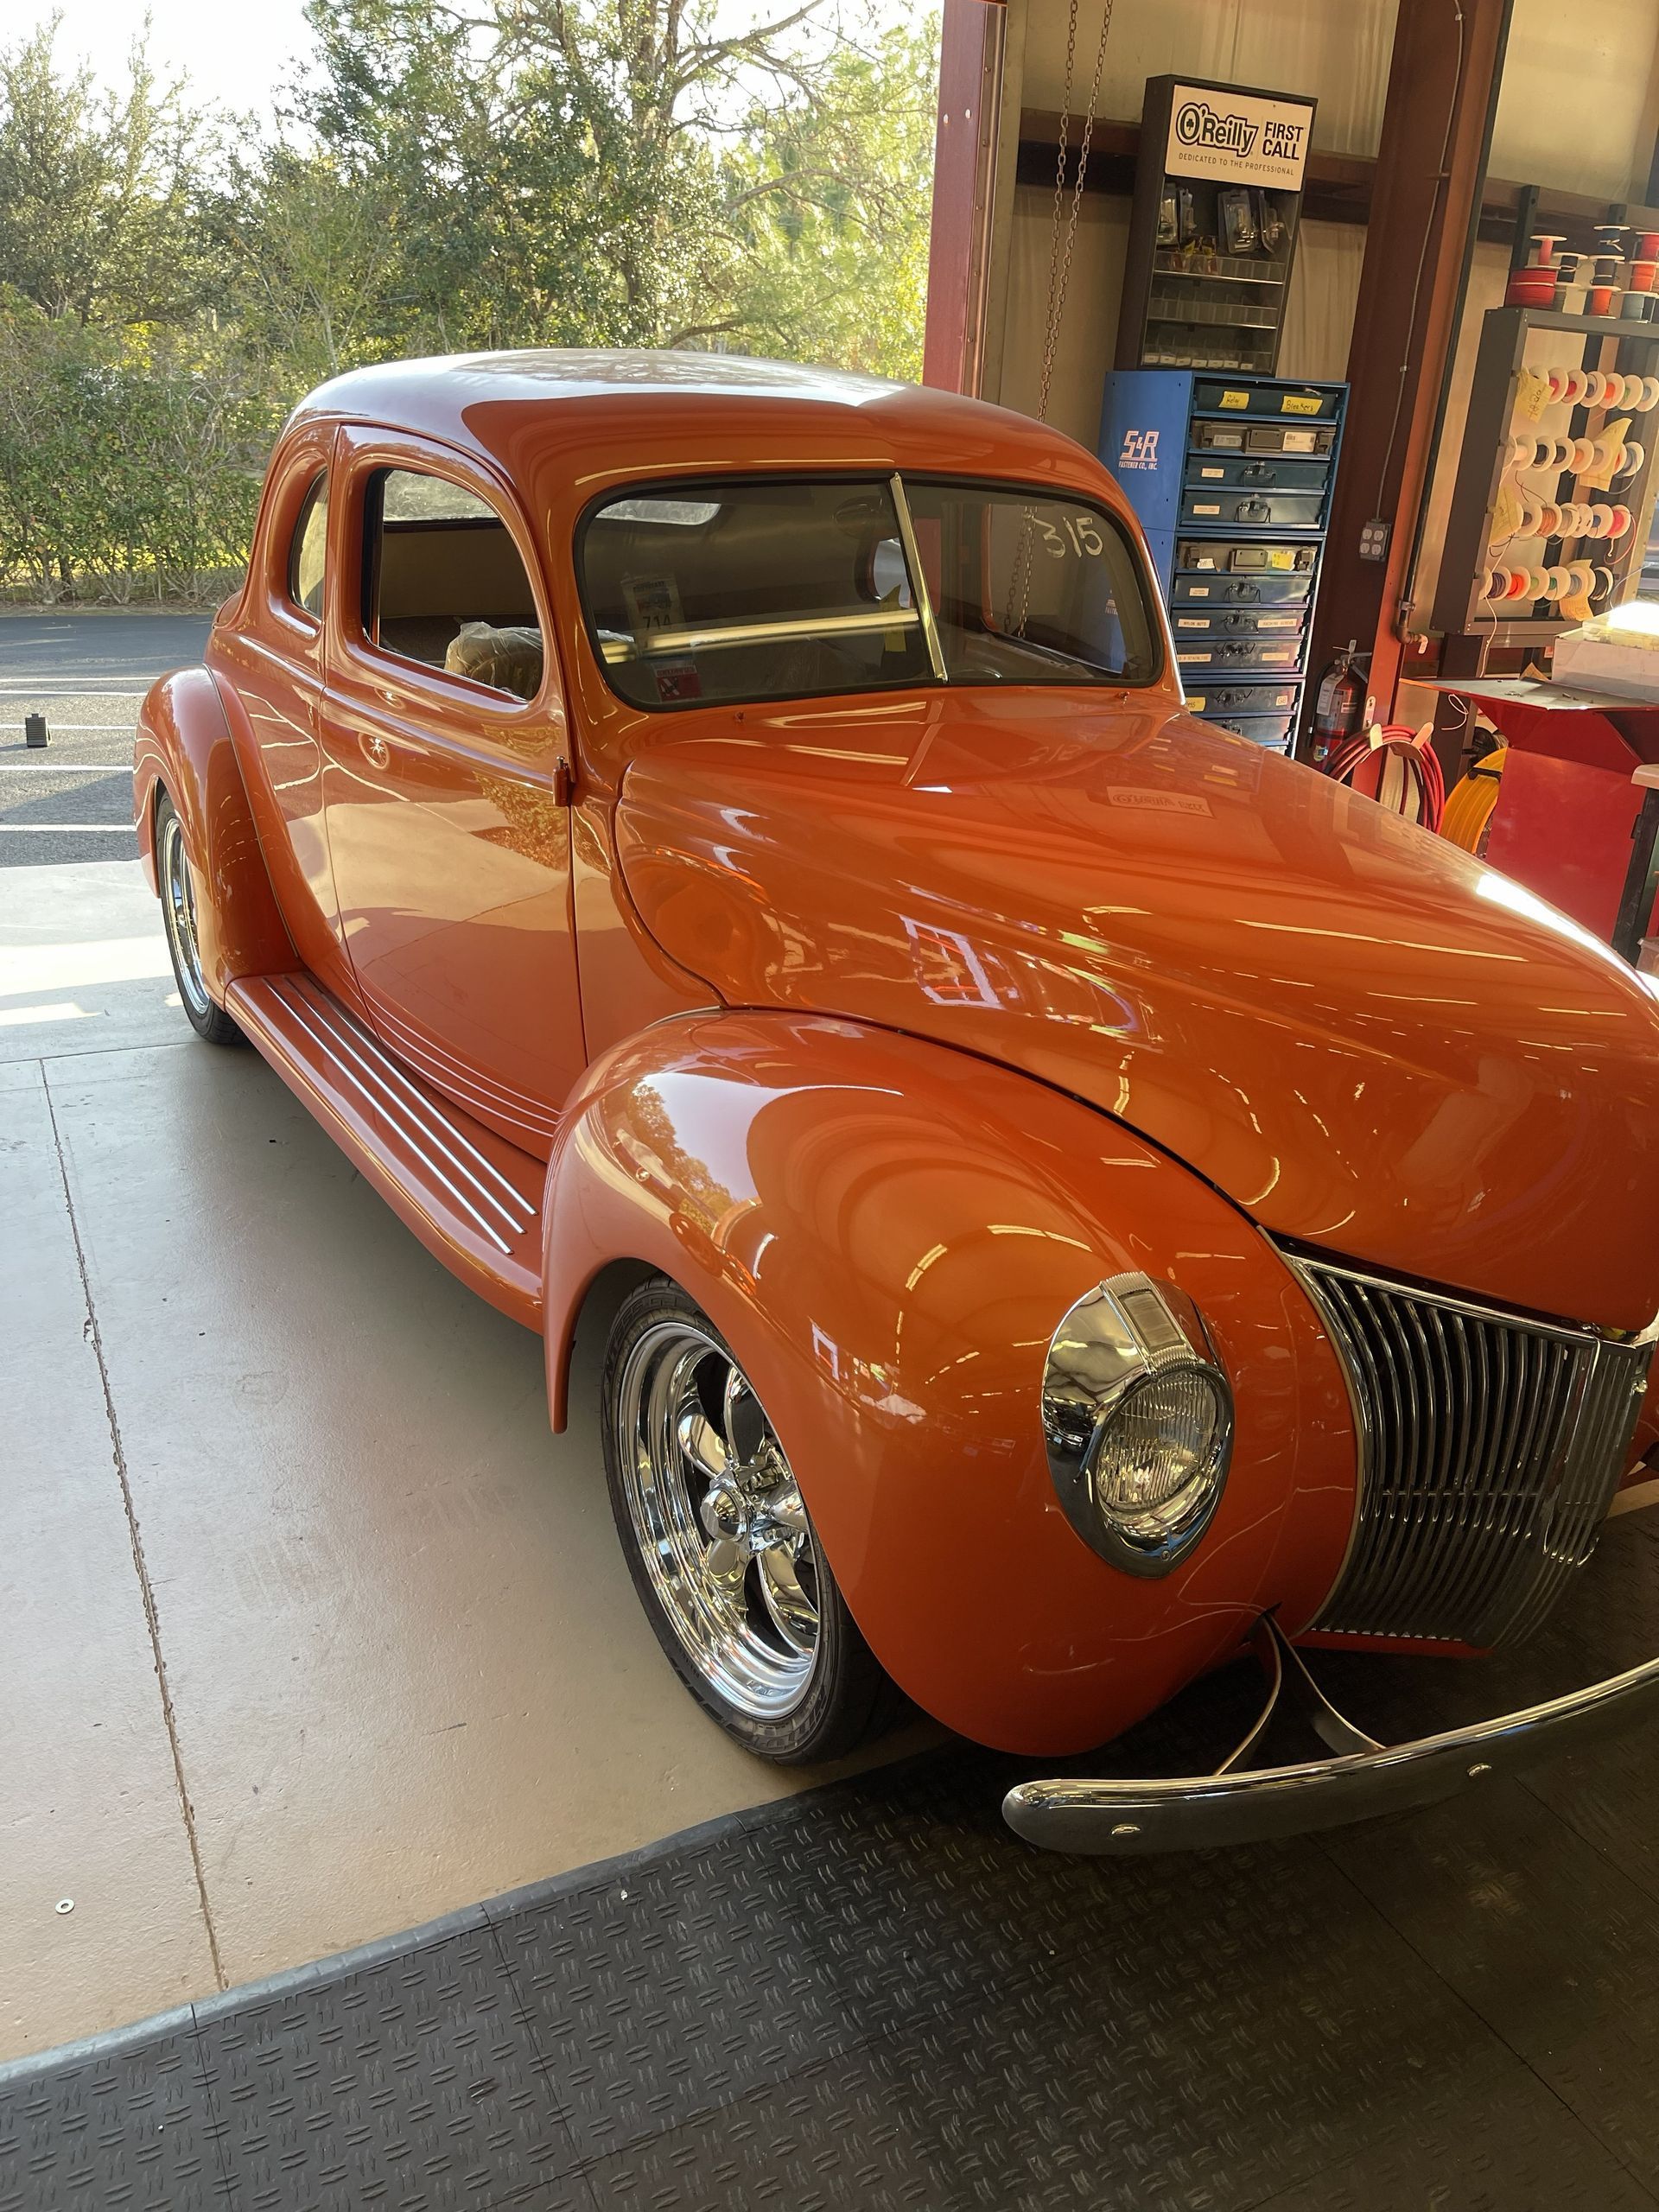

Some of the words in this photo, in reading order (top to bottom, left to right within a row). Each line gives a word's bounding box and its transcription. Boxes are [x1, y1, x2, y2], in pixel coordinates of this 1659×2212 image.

[1179, 106, 1255, 153] O'Reilly
[1264, 121, 1304, 143] FIRST
[1262, 139, 1300, 161] CALL
[1179, 152, 1217, 164] DEDICATED
[1219, 157, 1228, 166] TO
[1230, 160, 1243, 168] THE
[1245, 162, 1294, 175] PROFESSIONAL
[1120, 430, 1160, 459] S&R
[1118, 461, 1139, 469] FASTENER
[1032, 517, 1103, 558] 315
